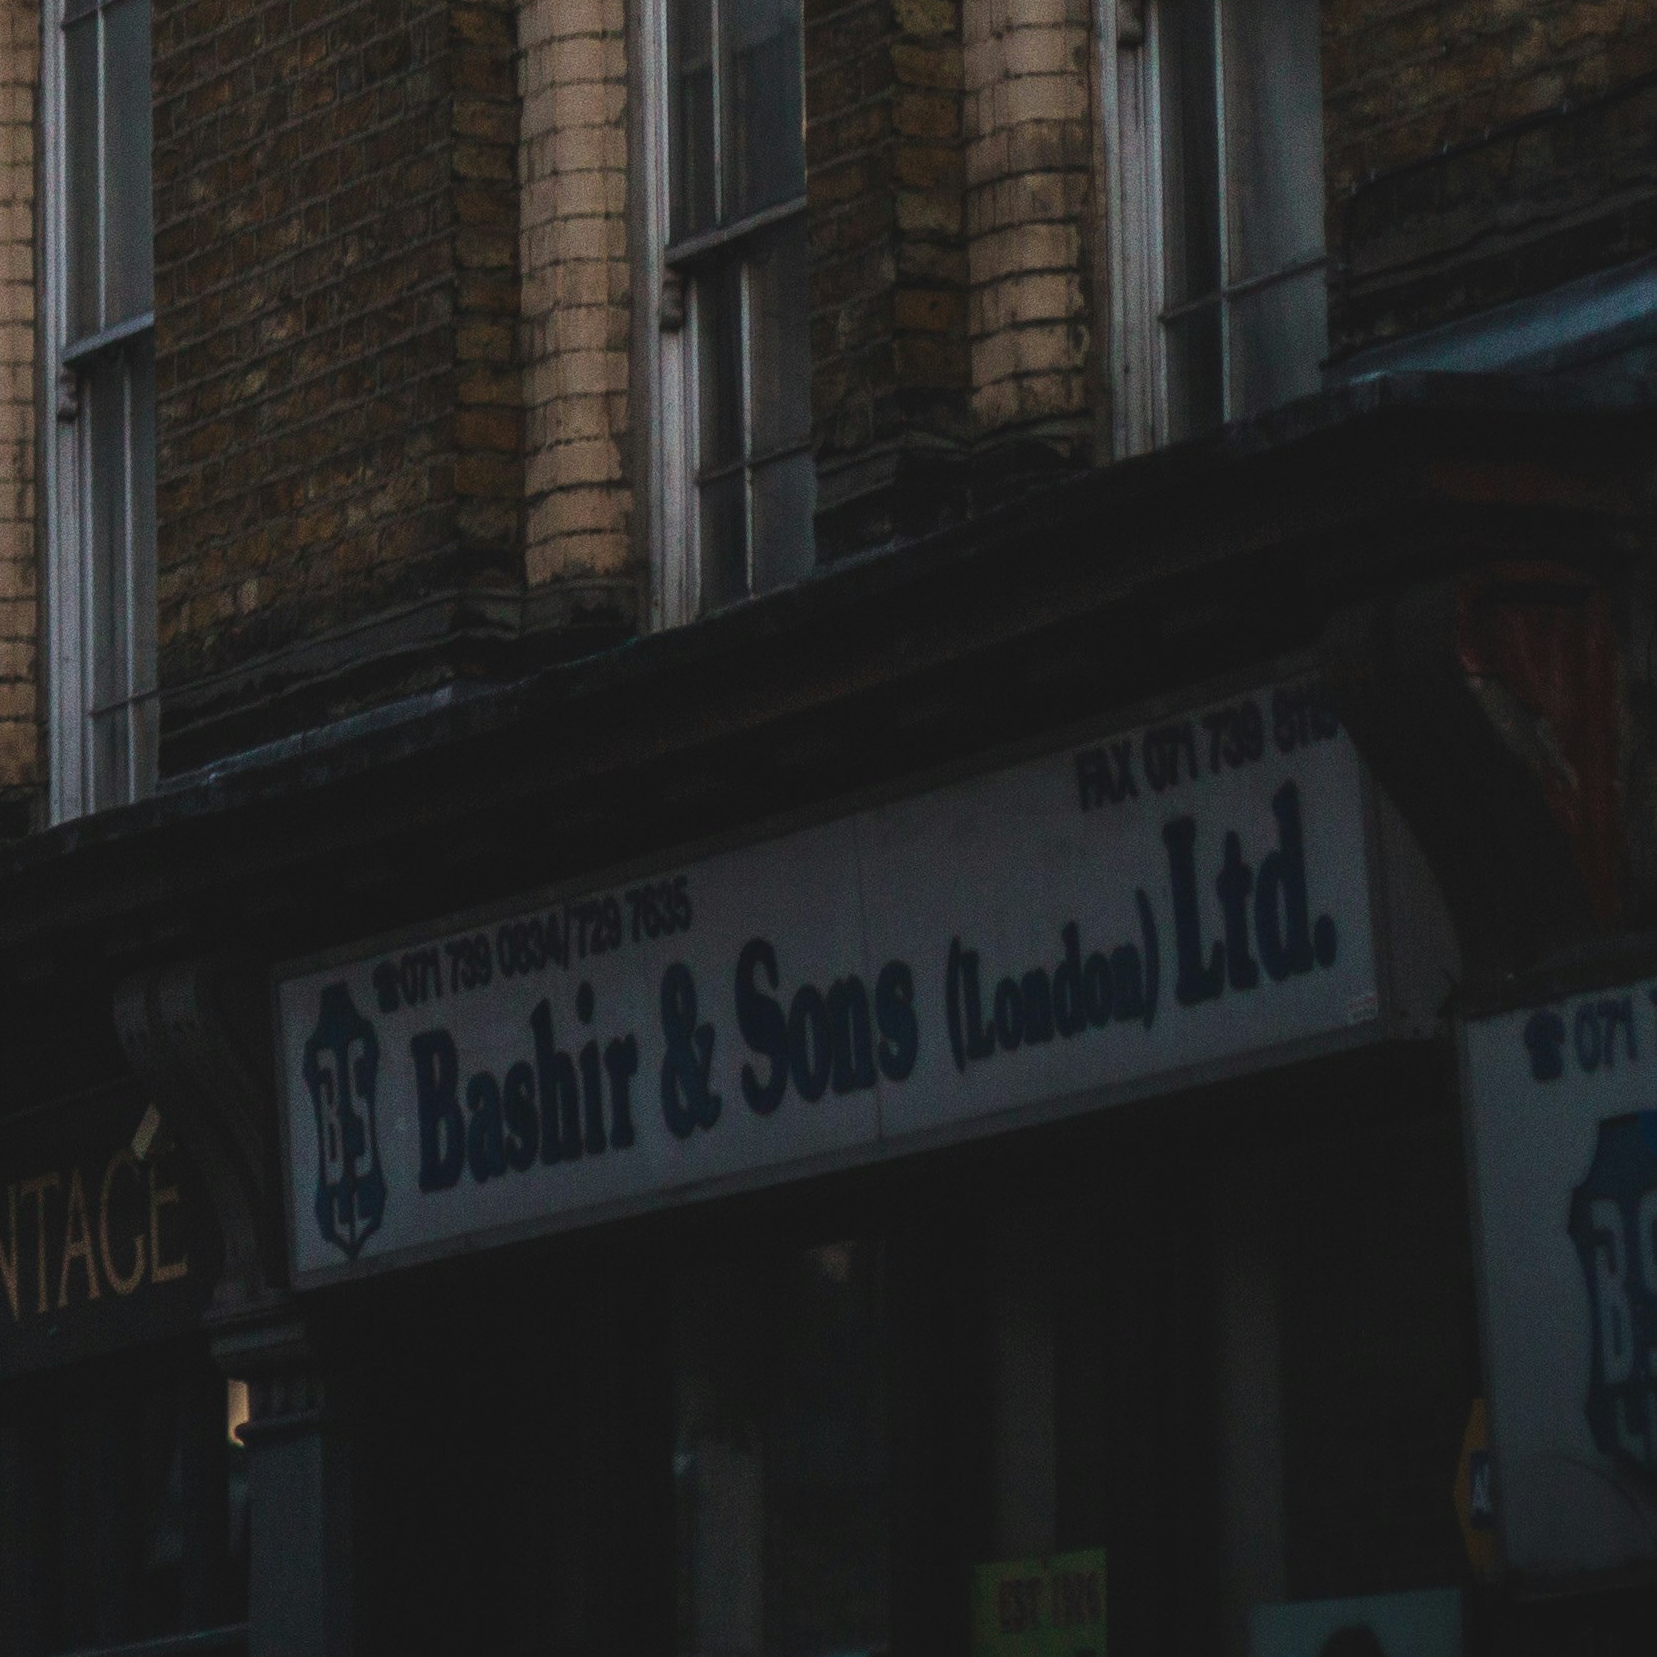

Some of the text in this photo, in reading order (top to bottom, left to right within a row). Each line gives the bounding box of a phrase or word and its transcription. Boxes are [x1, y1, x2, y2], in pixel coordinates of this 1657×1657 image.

[1075, 740, 1138, 812] FAX
[1143, 721, 1198, 793] 071
[1203, 700, 1263, 774] 739
[401, 947, 442, 1007] 071
[445, 933, 493, 994] 739
[410, 778, 1338, 1193] Bashir & Sons (London) Ltd.
[1574, 996, 1638, 1074] 071
